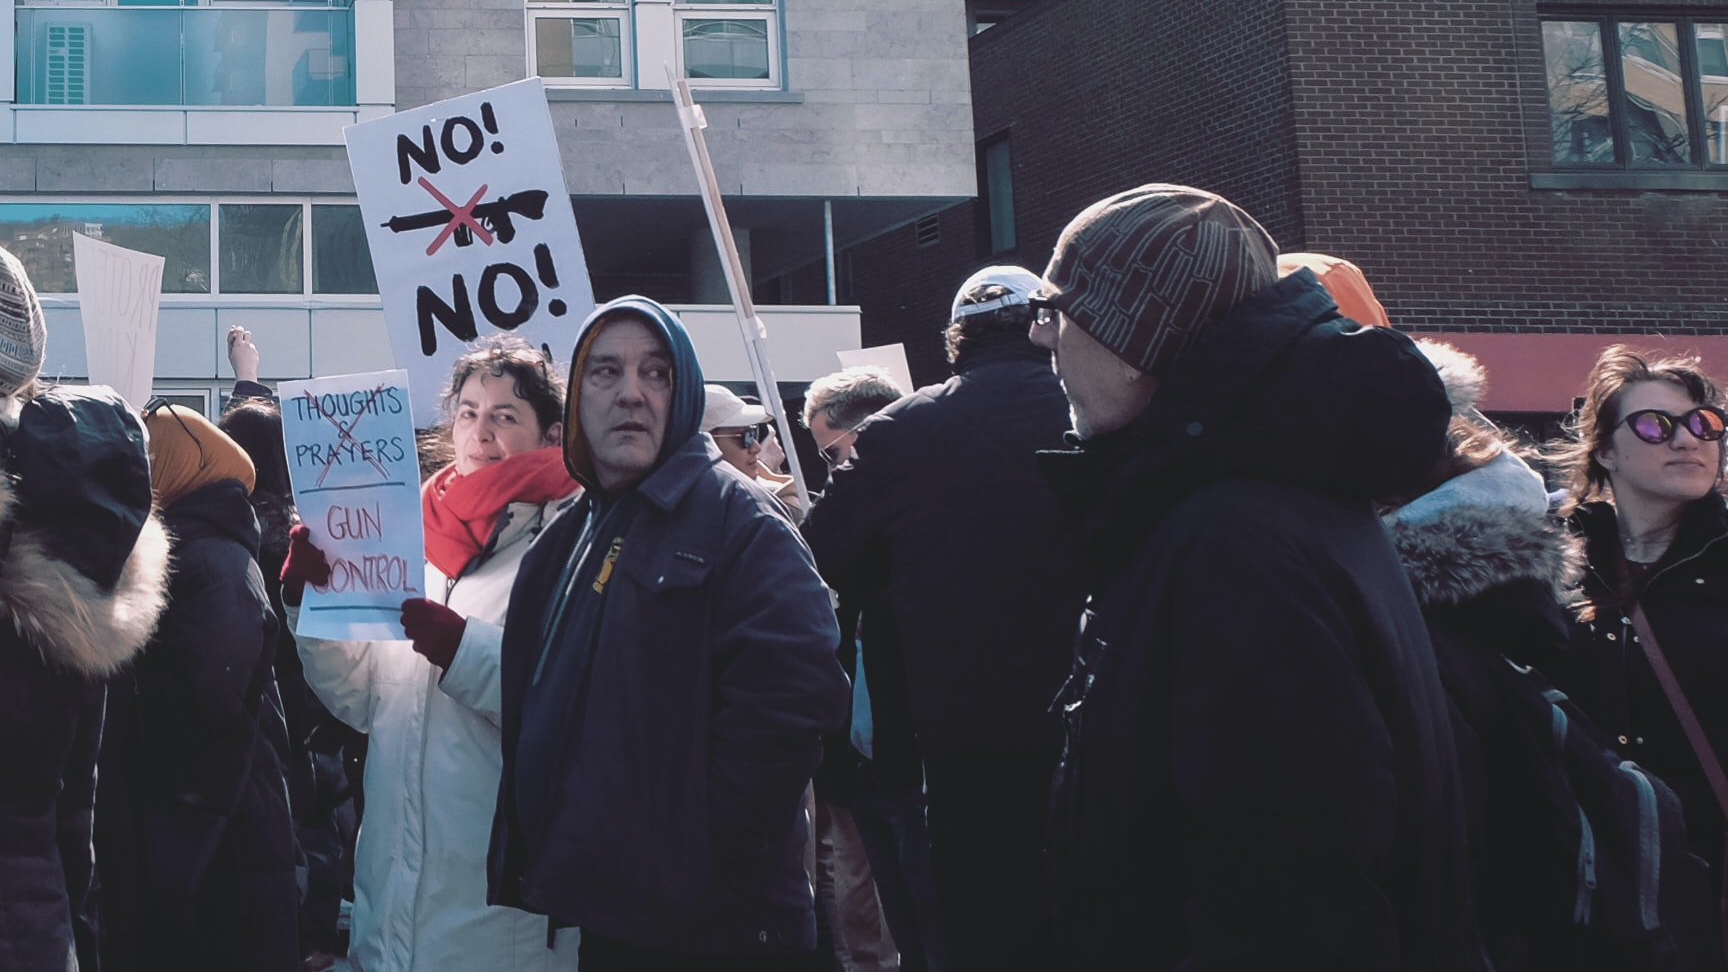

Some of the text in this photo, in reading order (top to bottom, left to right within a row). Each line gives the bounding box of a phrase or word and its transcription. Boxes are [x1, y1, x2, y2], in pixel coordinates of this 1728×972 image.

[397, 102, 504, 185] NO!
[416, 243, 567, 356] NO!
[291, 386, 403, 421] THOUGHTS
[295, 436, 405, 467] PRAYERS
[327, 501, 383, 541] GUN
